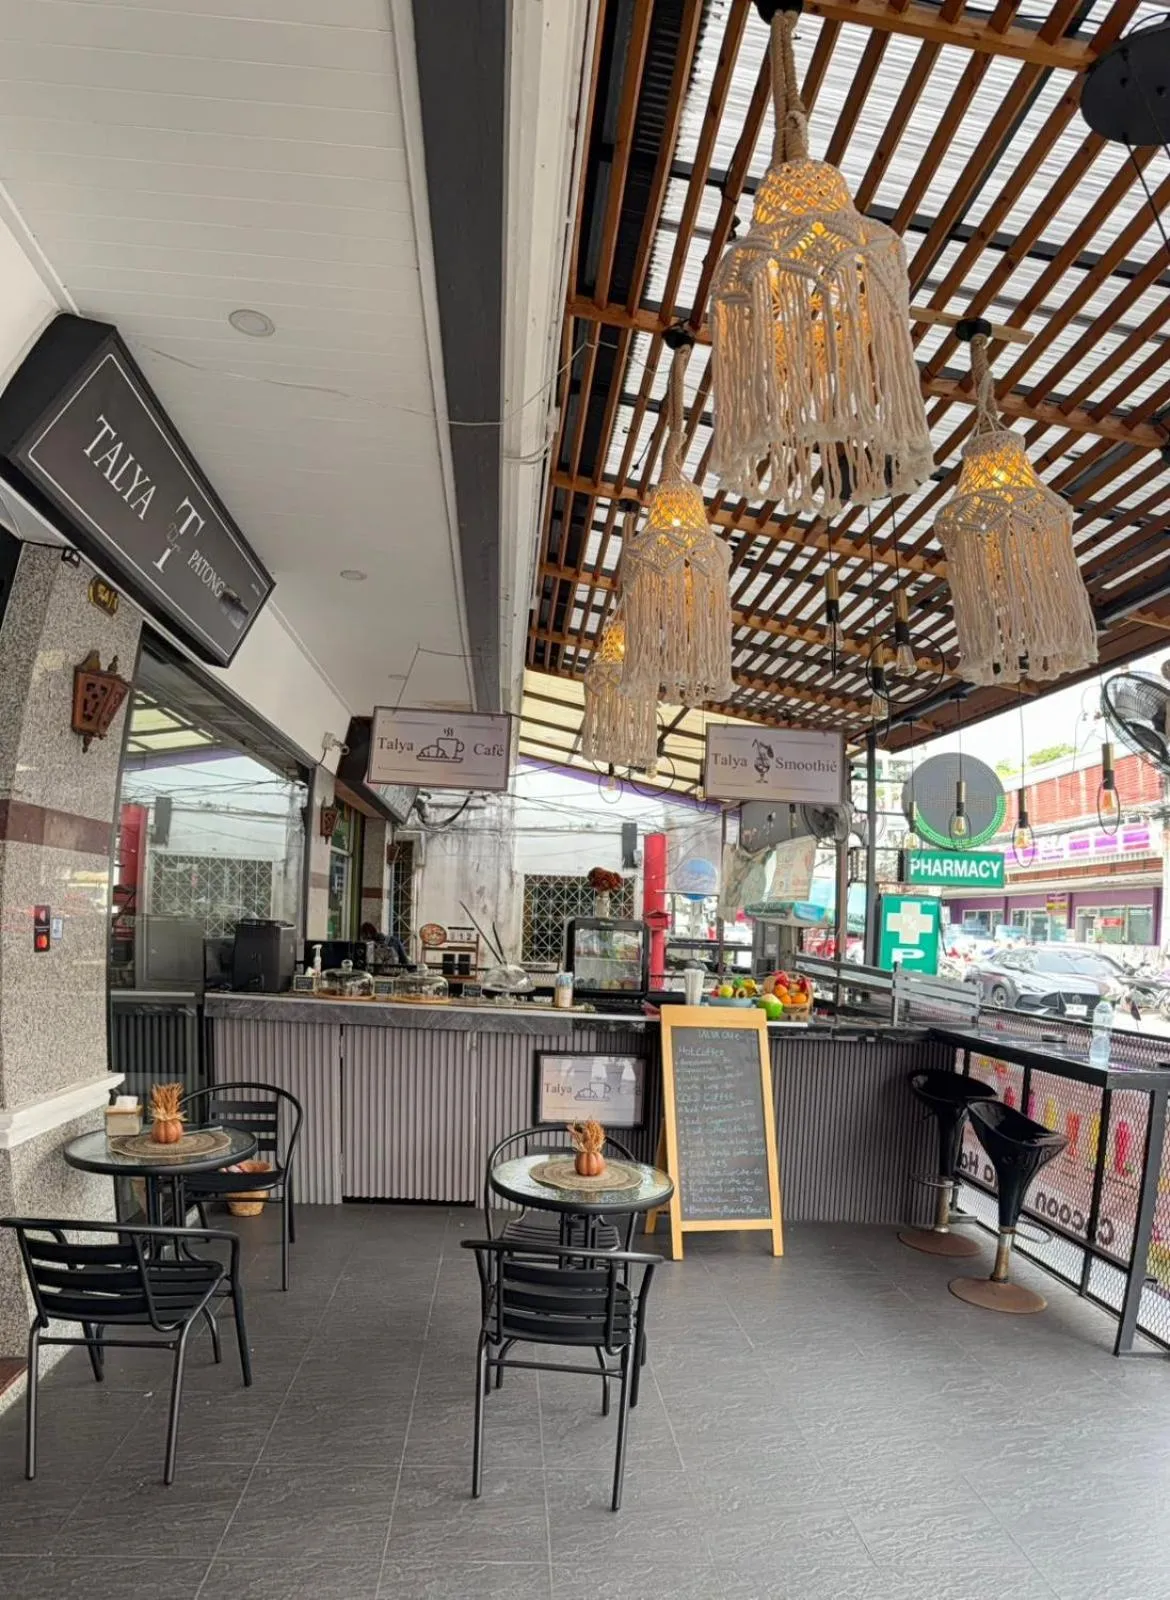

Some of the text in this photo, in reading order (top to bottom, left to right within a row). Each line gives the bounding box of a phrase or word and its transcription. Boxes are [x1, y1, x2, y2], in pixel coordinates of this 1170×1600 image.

[83, 414, 156, 520] TALYA
[187, 549, 226, 597] PATONG
[378, 737, 504, 757] Talya Café
[711, 753, 748, 769] Talya
[910, 858, 1001, 878] PHARMACY
[544, 1082, 572, 1096] Talya
